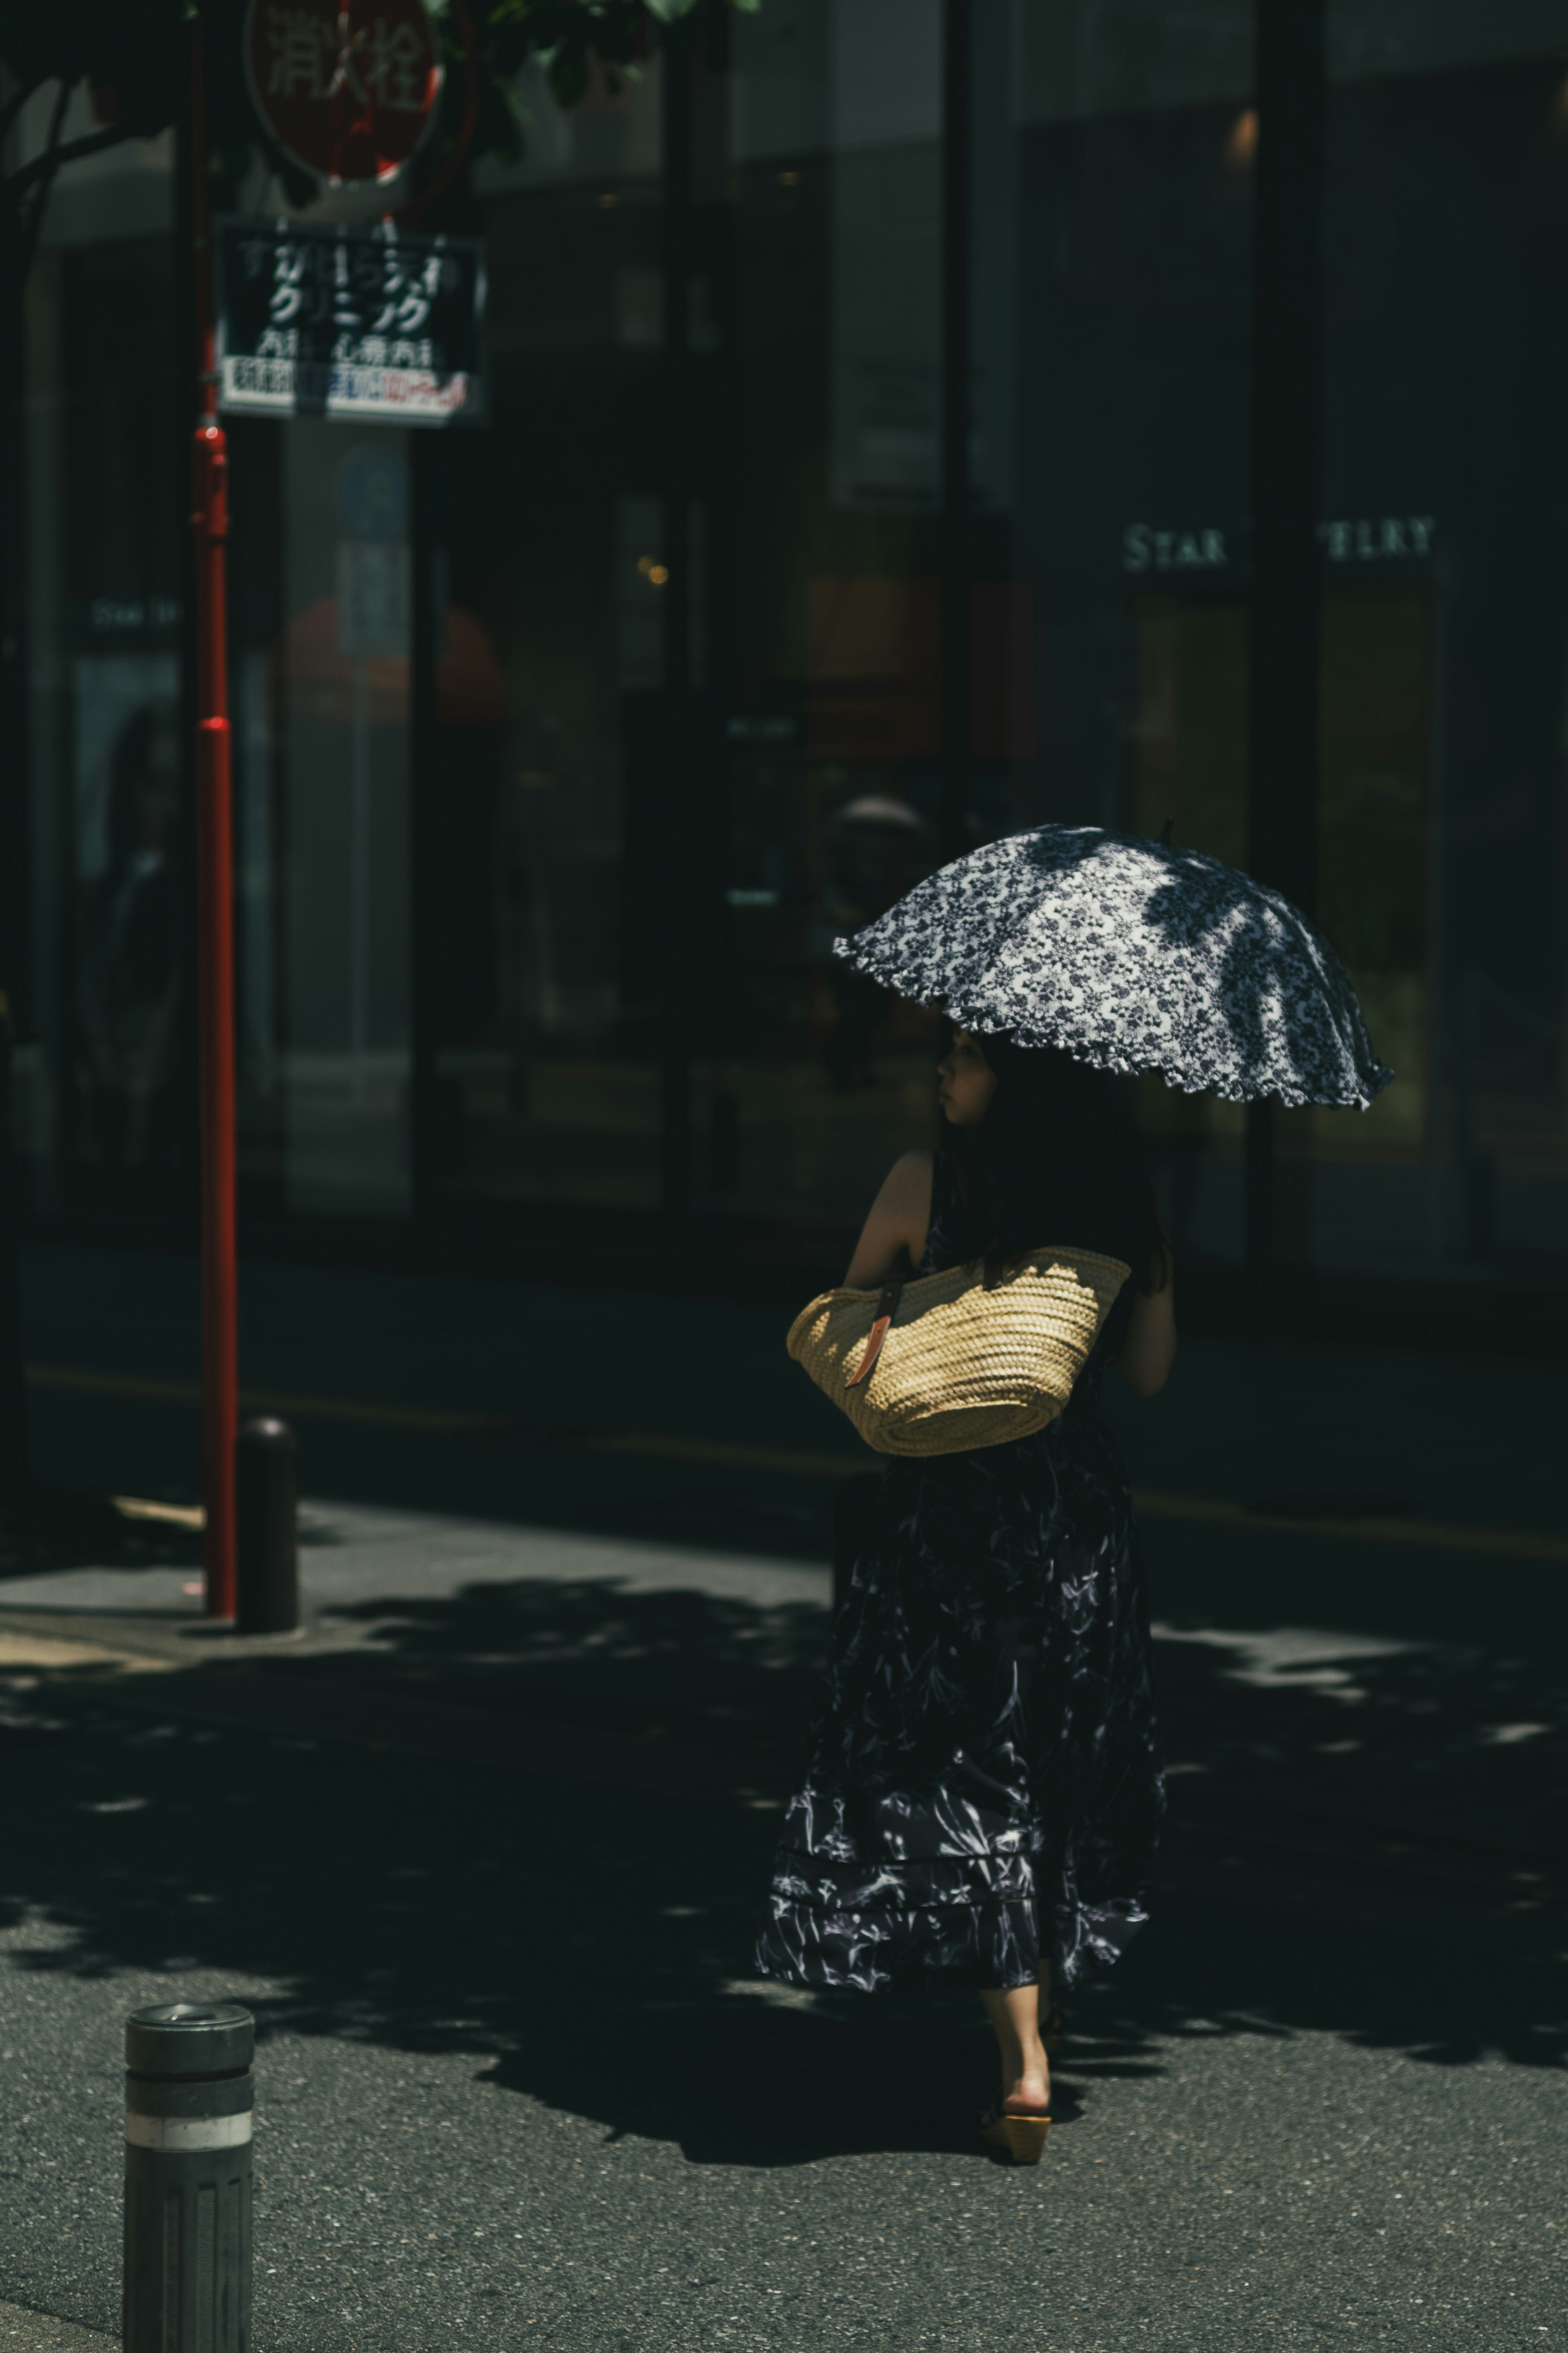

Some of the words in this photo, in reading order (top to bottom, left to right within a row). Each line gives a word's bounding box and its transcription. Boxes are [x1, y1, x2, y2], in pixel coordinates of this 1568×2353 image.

[265, 5, 425, 113] 消火栓
[267, 285, 432, 334] クリニック
[1122, 522, 1229, 573] STAR
[1313, 515, 1437, 562] ELRY
